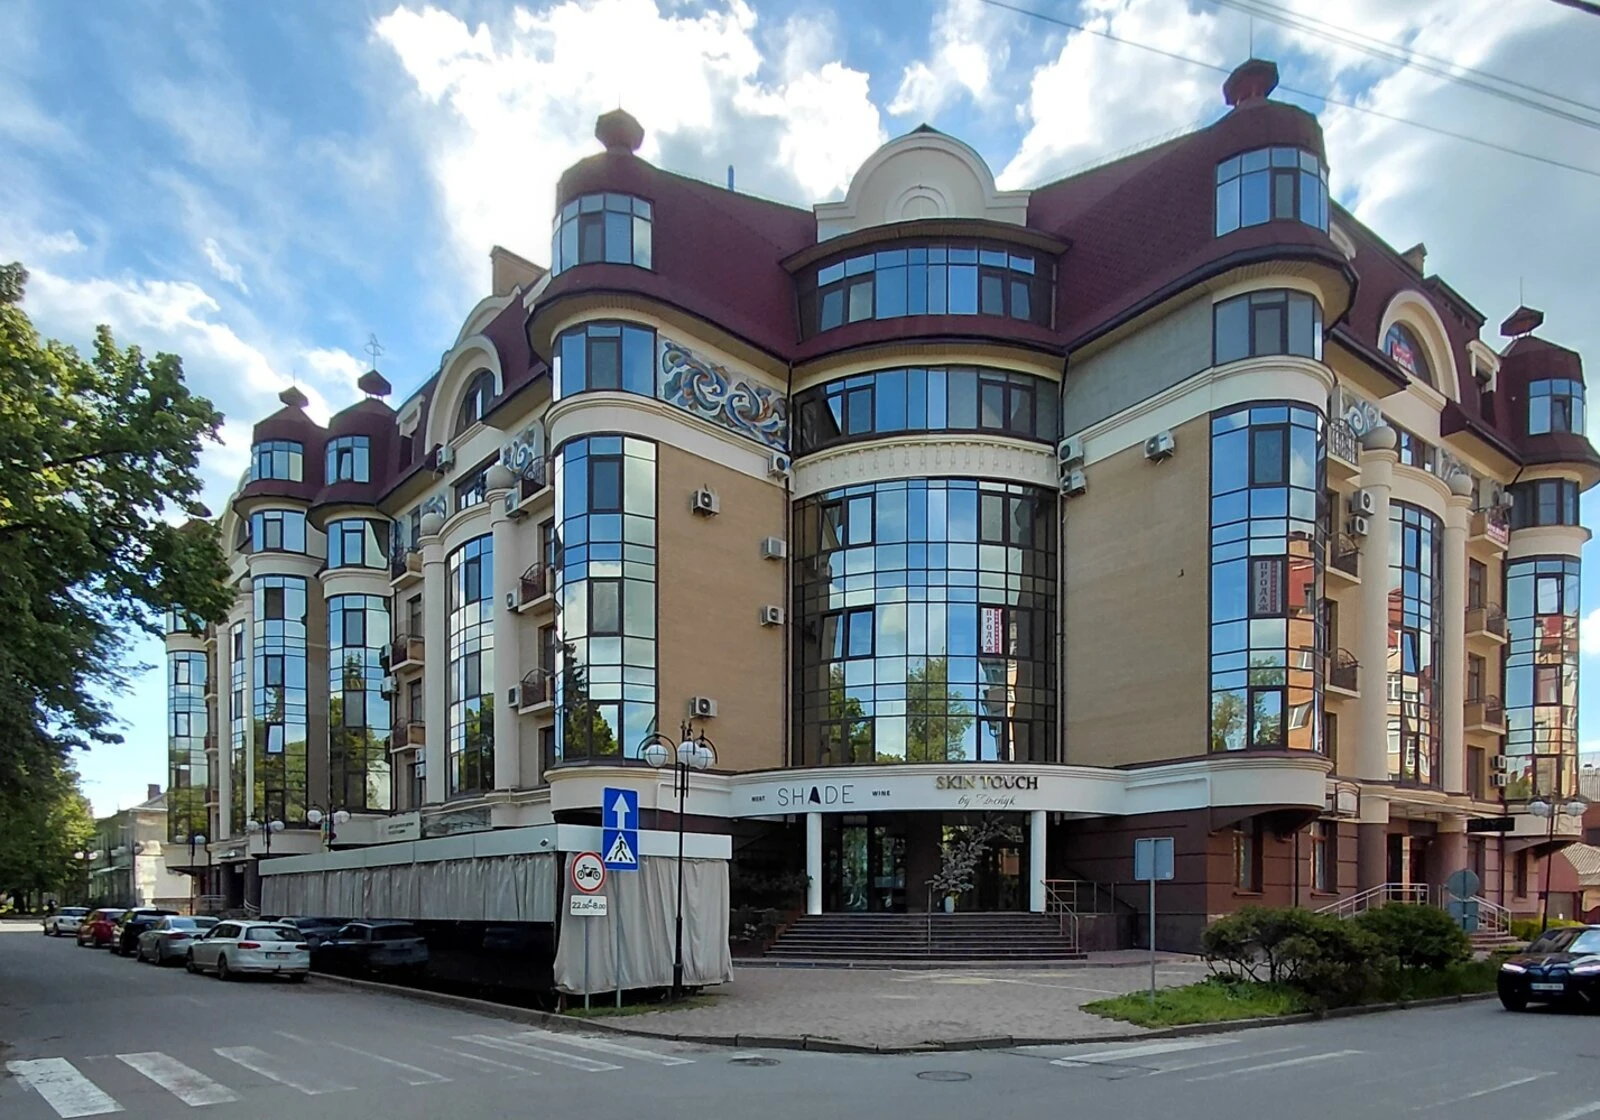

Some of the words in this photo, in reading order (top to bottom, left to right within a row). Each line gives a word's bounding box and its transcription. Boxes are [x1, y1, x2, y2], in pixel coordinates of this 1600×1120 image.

[985, 609, 994, 652] ПРОДАЖ
[936, 775, 975, 790] SKIN
[981, 775, 1038, 790] TOUCH
[777, 784, 854, 806] SHADE
[957, 794, 970, 808] by
